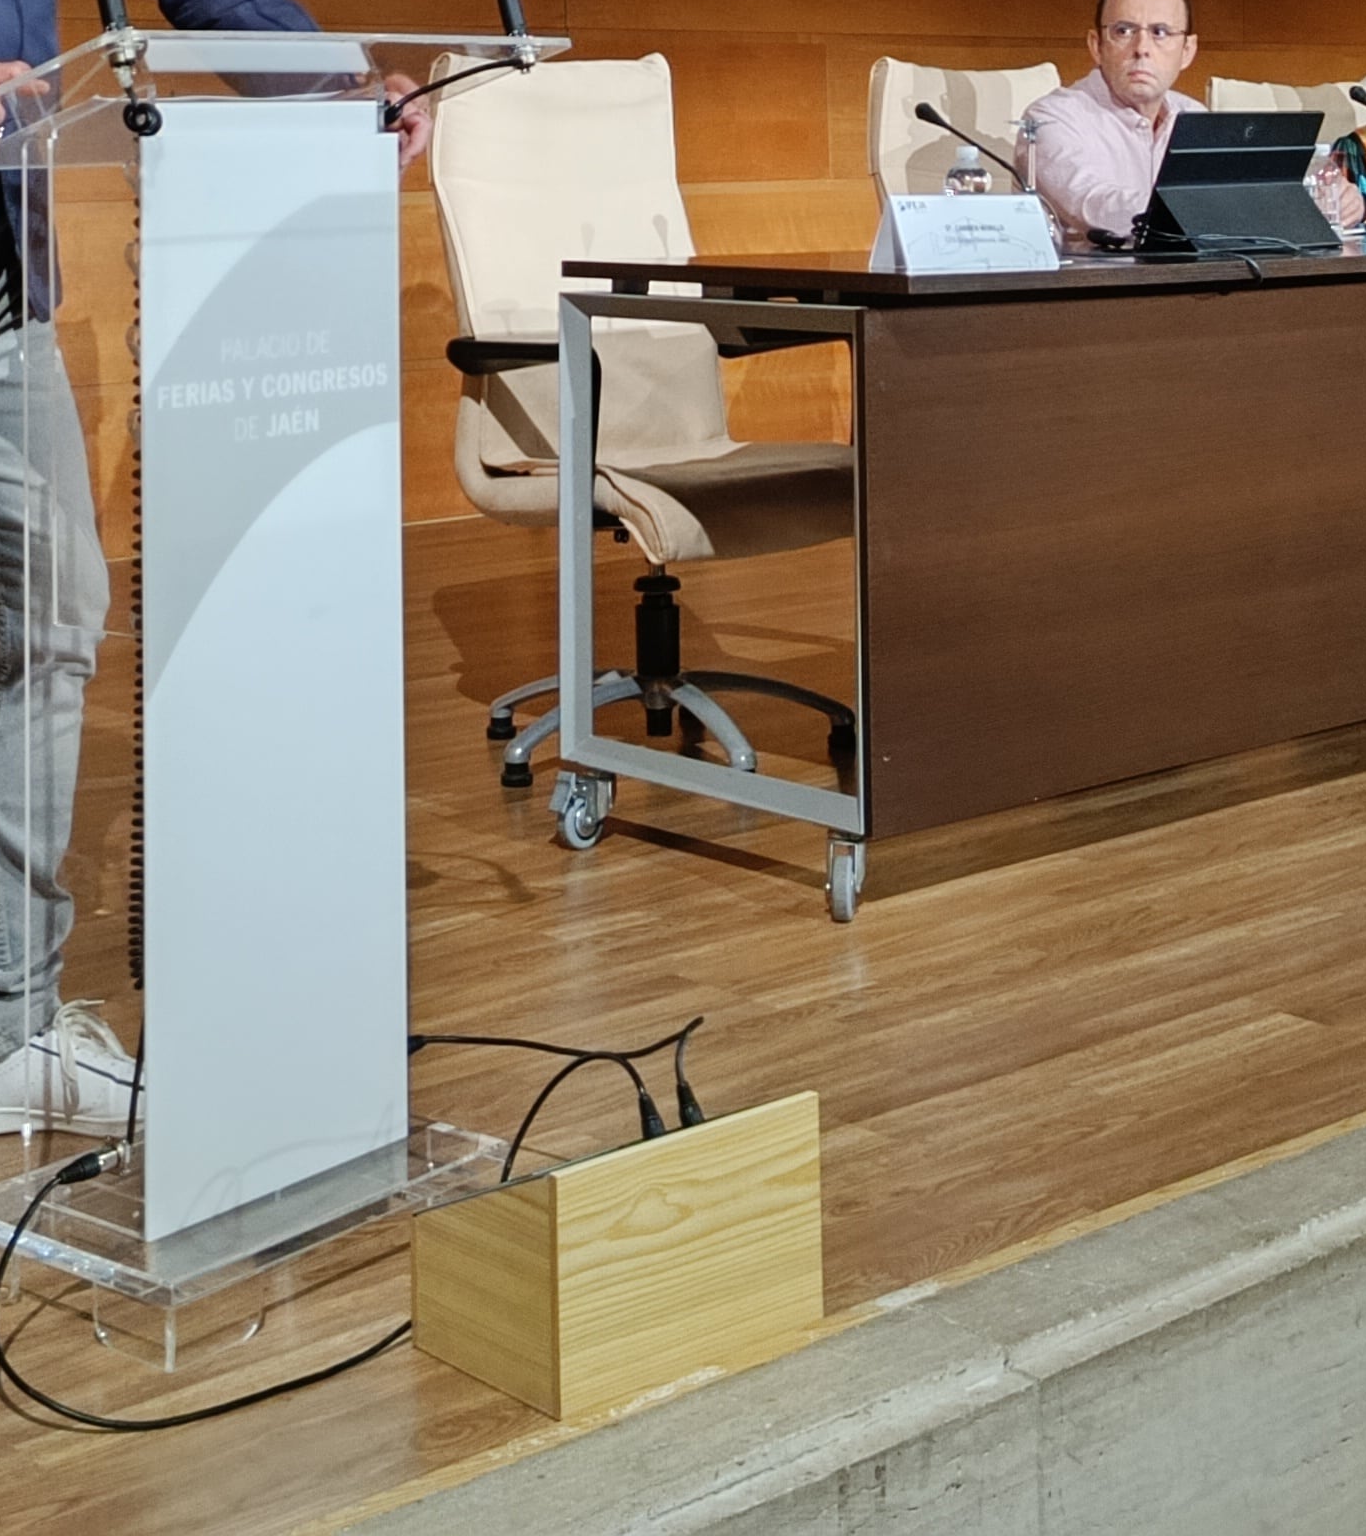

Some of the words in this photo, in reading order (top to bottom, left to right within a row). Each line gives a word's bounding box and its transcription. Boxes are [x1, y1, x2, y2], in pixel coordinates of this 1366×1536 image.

[220, 333, 301, 362] PALACIO
[306, 329, 330, 355] DE
[157, 378, 235, 409] FERIAS
[242, 376, 255, 400] Y
[261, 362, 388, 399] CONGRESOS
[235, 415, 259, 442] DE
[266, 405, 319, 439] JAÉN
